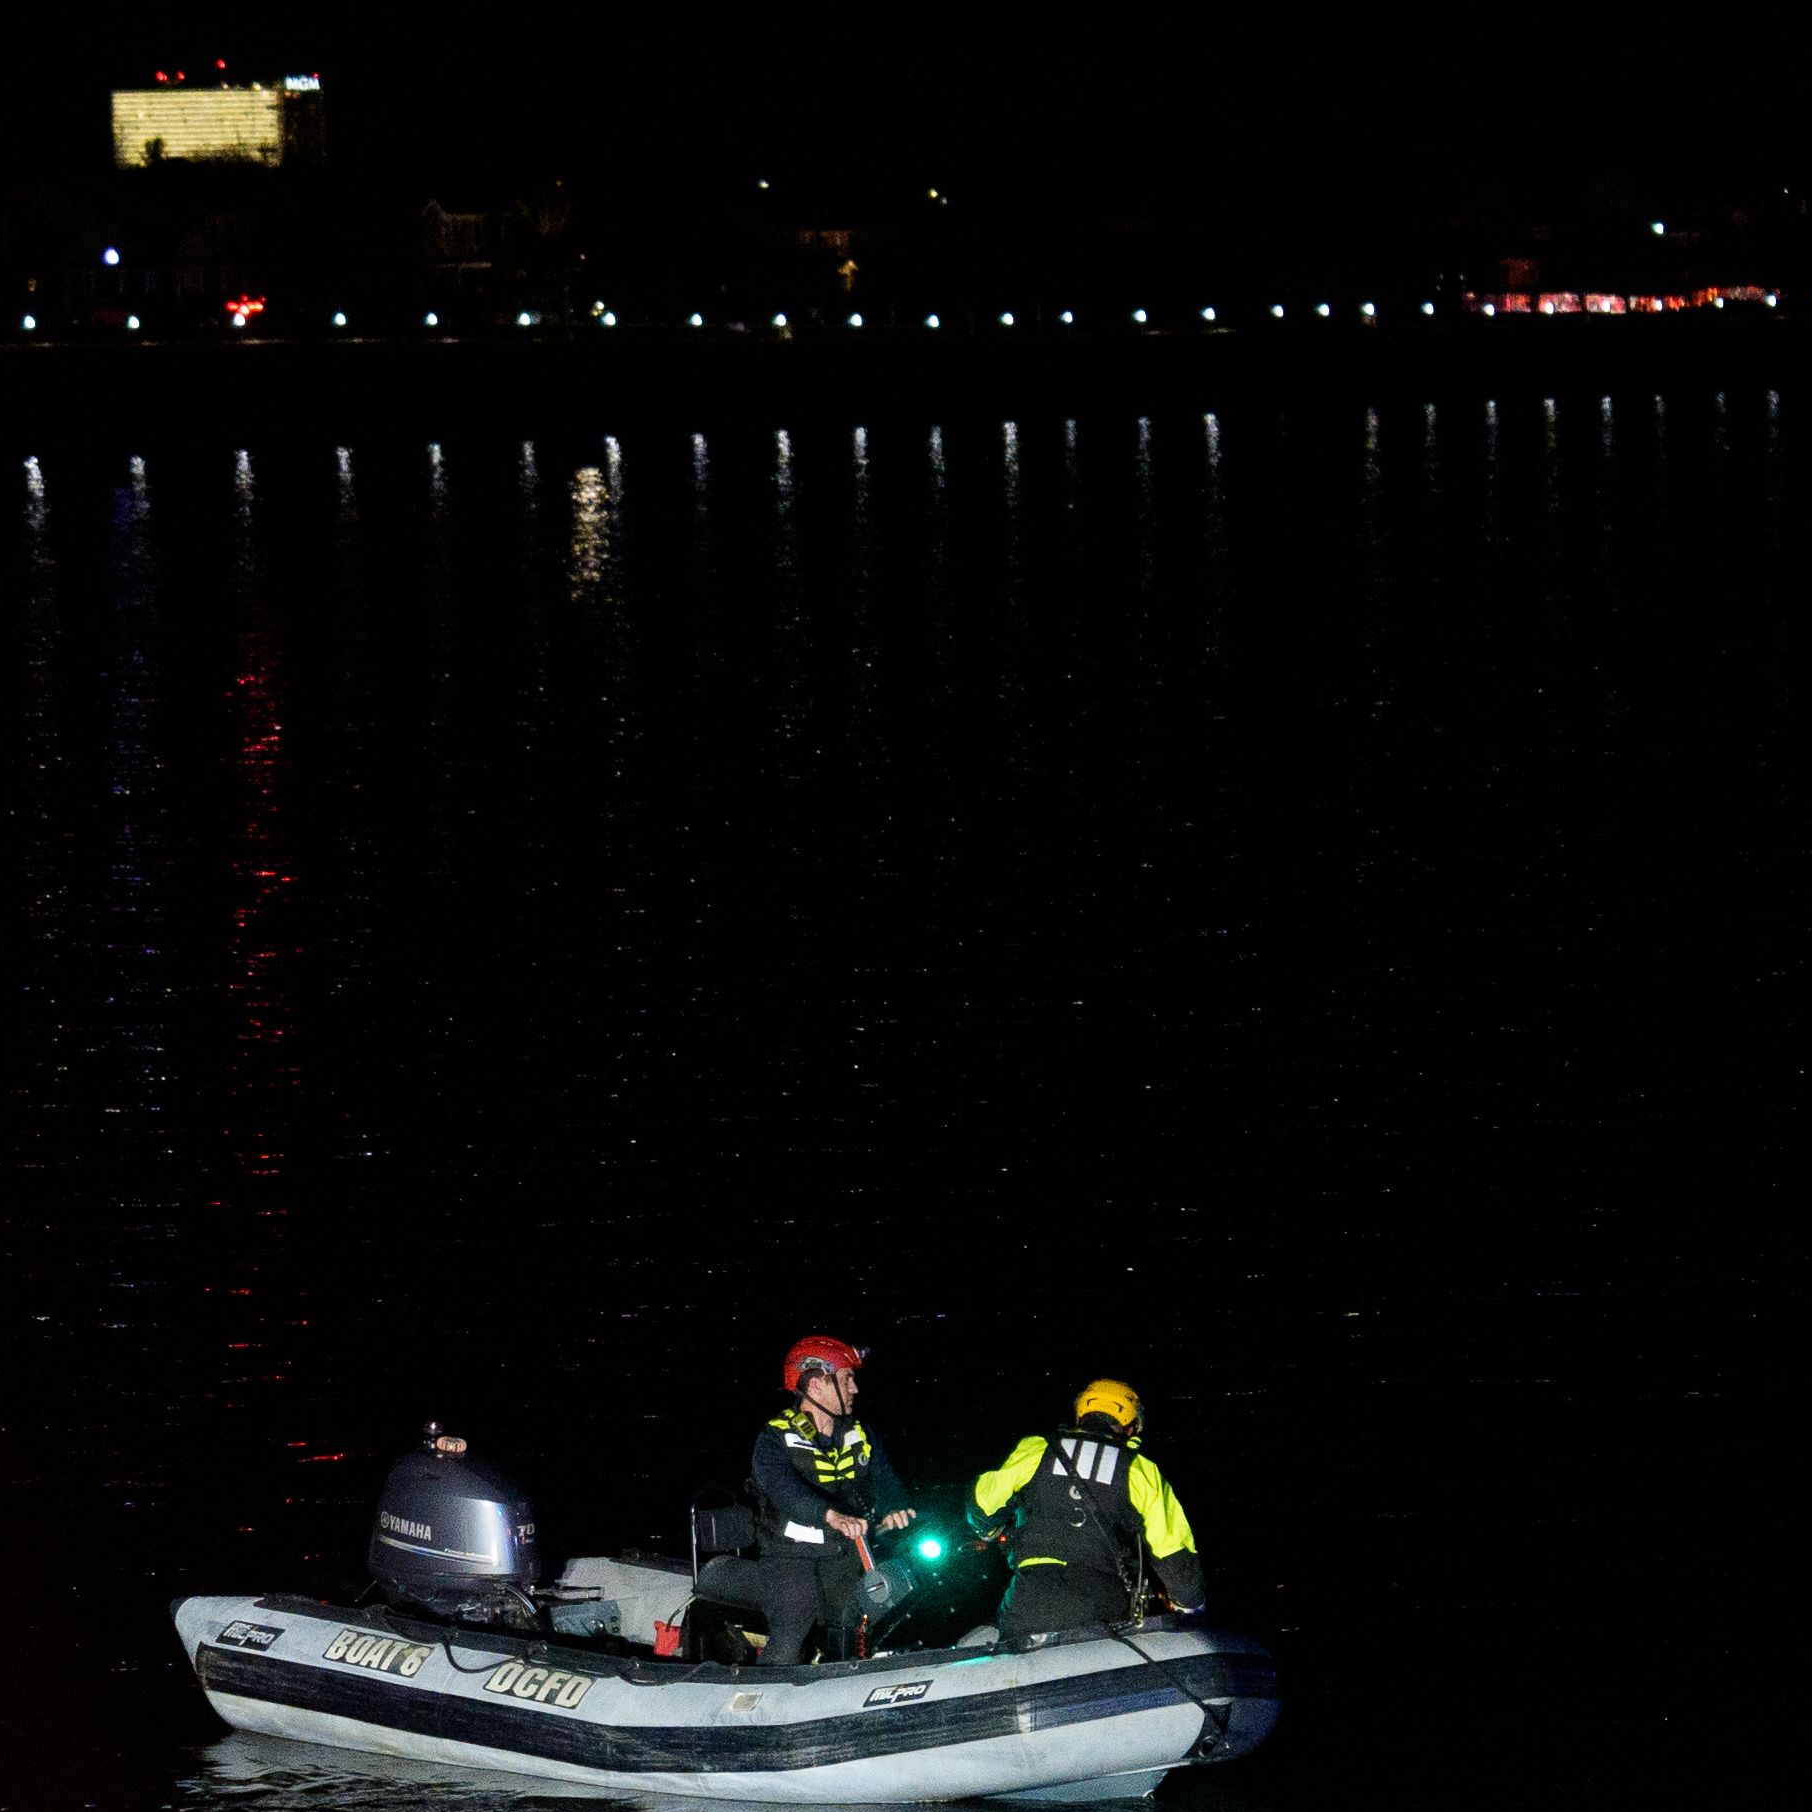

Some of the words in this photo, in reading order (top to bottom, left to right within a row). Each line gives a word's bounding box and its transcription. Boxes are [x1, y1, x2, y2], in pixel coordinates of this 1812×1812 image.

[389, 1514, 433, 1542] YAMAHA
[324, 1629, 409, 1671] BOAT
[399, 1645, 431, 1677] 6
[485, 1662, 593, 1708] DCFD
